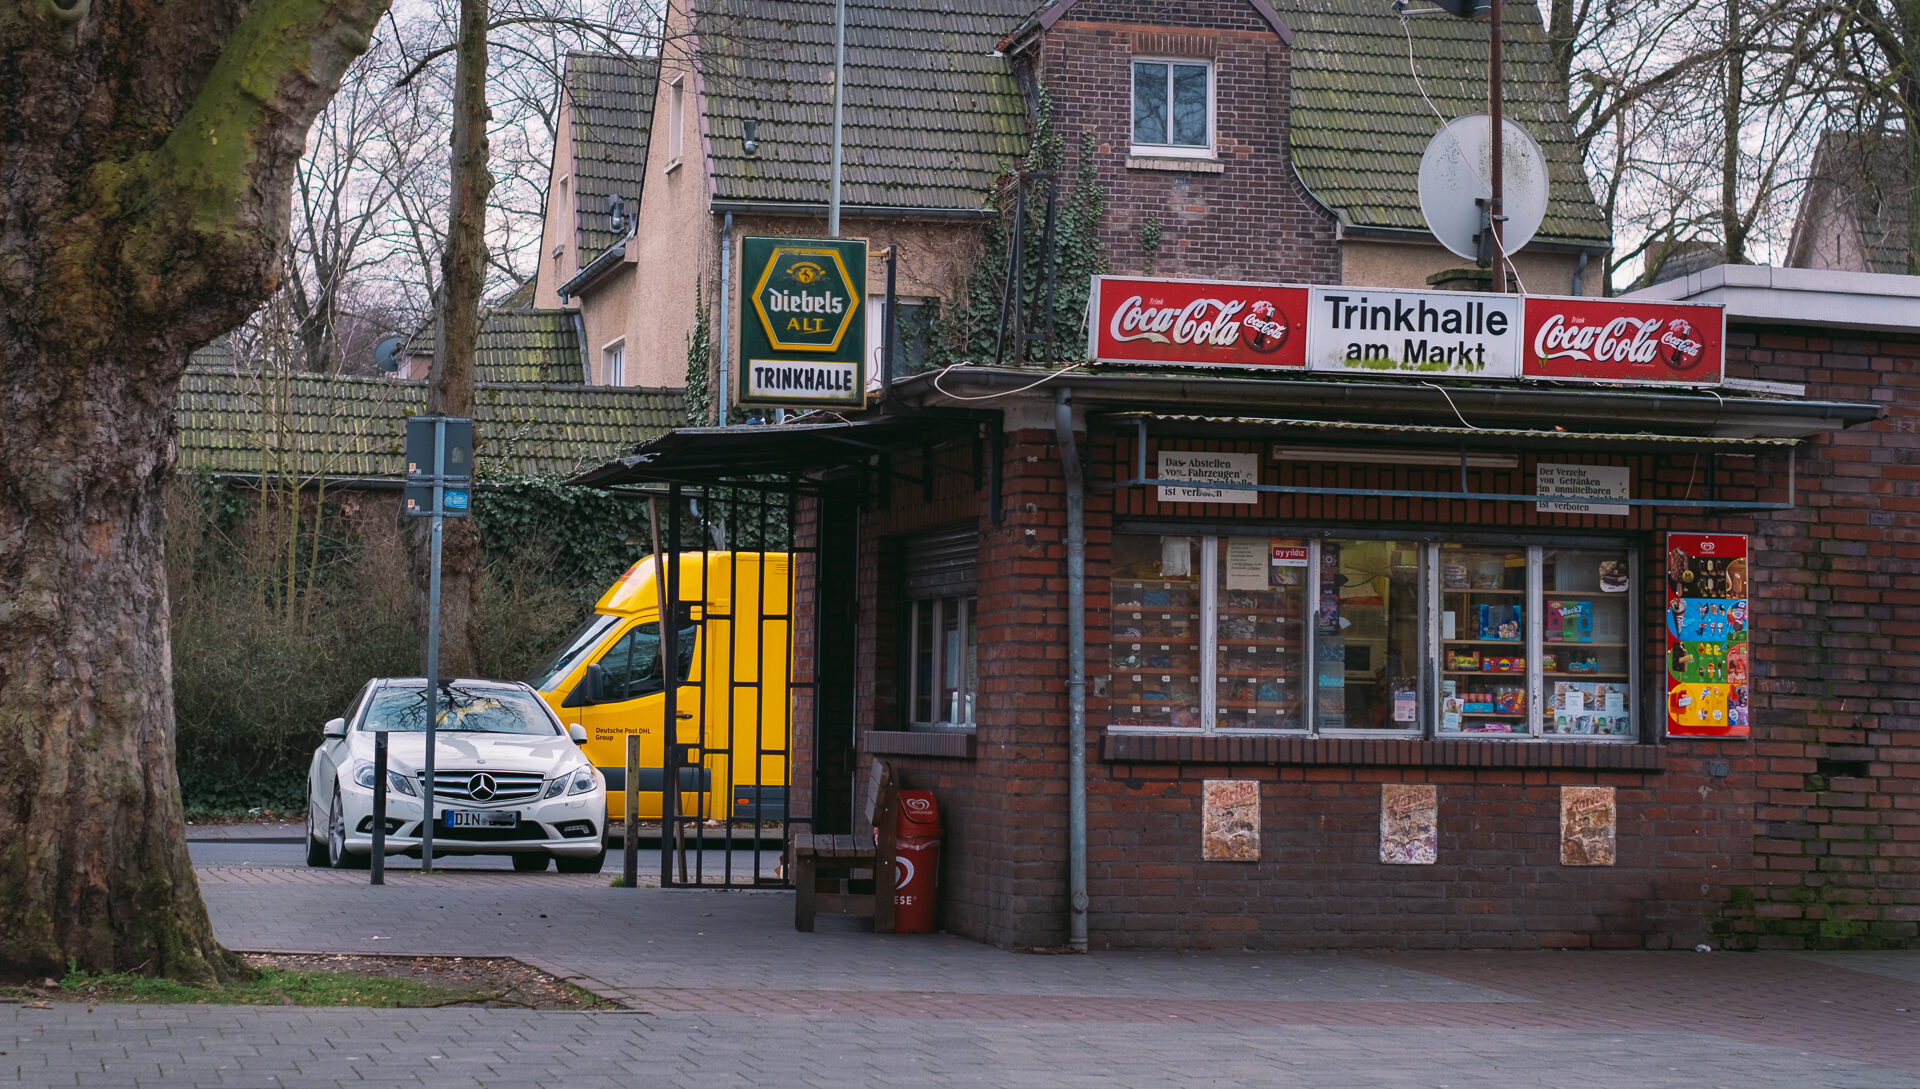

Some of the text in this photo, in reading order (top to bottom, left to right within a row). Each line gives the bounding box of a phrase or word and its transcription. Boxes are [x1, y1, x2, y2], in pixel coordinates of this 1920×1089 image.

[768, 288, 843, 314] diebels
[1149, 297, 1164, 305] Trink
[1110, 295, 1247, 346] Coca-Cola
[1323, 295, 1508, 336] Trinkhalle
[1571, 316, 1586, 324] Trink
[786, 317, 826, 333] ALT
[1243, 313, 1287, 340] Coca-Cola
[1534, 313, 1664, 363] Coca-Cola
[1661, 331, 1702, 357] Coca-Cola
[1346, 339, 1486, 366] am Markt
[755, 366, 853, 391] TRINKHALLE
[1165, 457, 1231, 468] Das Abstellen
[1188, 468, 1240, 480] Fahrzeugen
[1539, 467, 1587, 477] Der Verzehr
[1559, 477, 1601, 486] Getränken
[1165, 486, 1176, 496] ist
[1539, 485, 1611, 495] im unmittelbaren
[1554, 502, 1590, 512] verboten
[1275, 549, 1285, 557] ay
[454, 812, 481, 826] DIN
